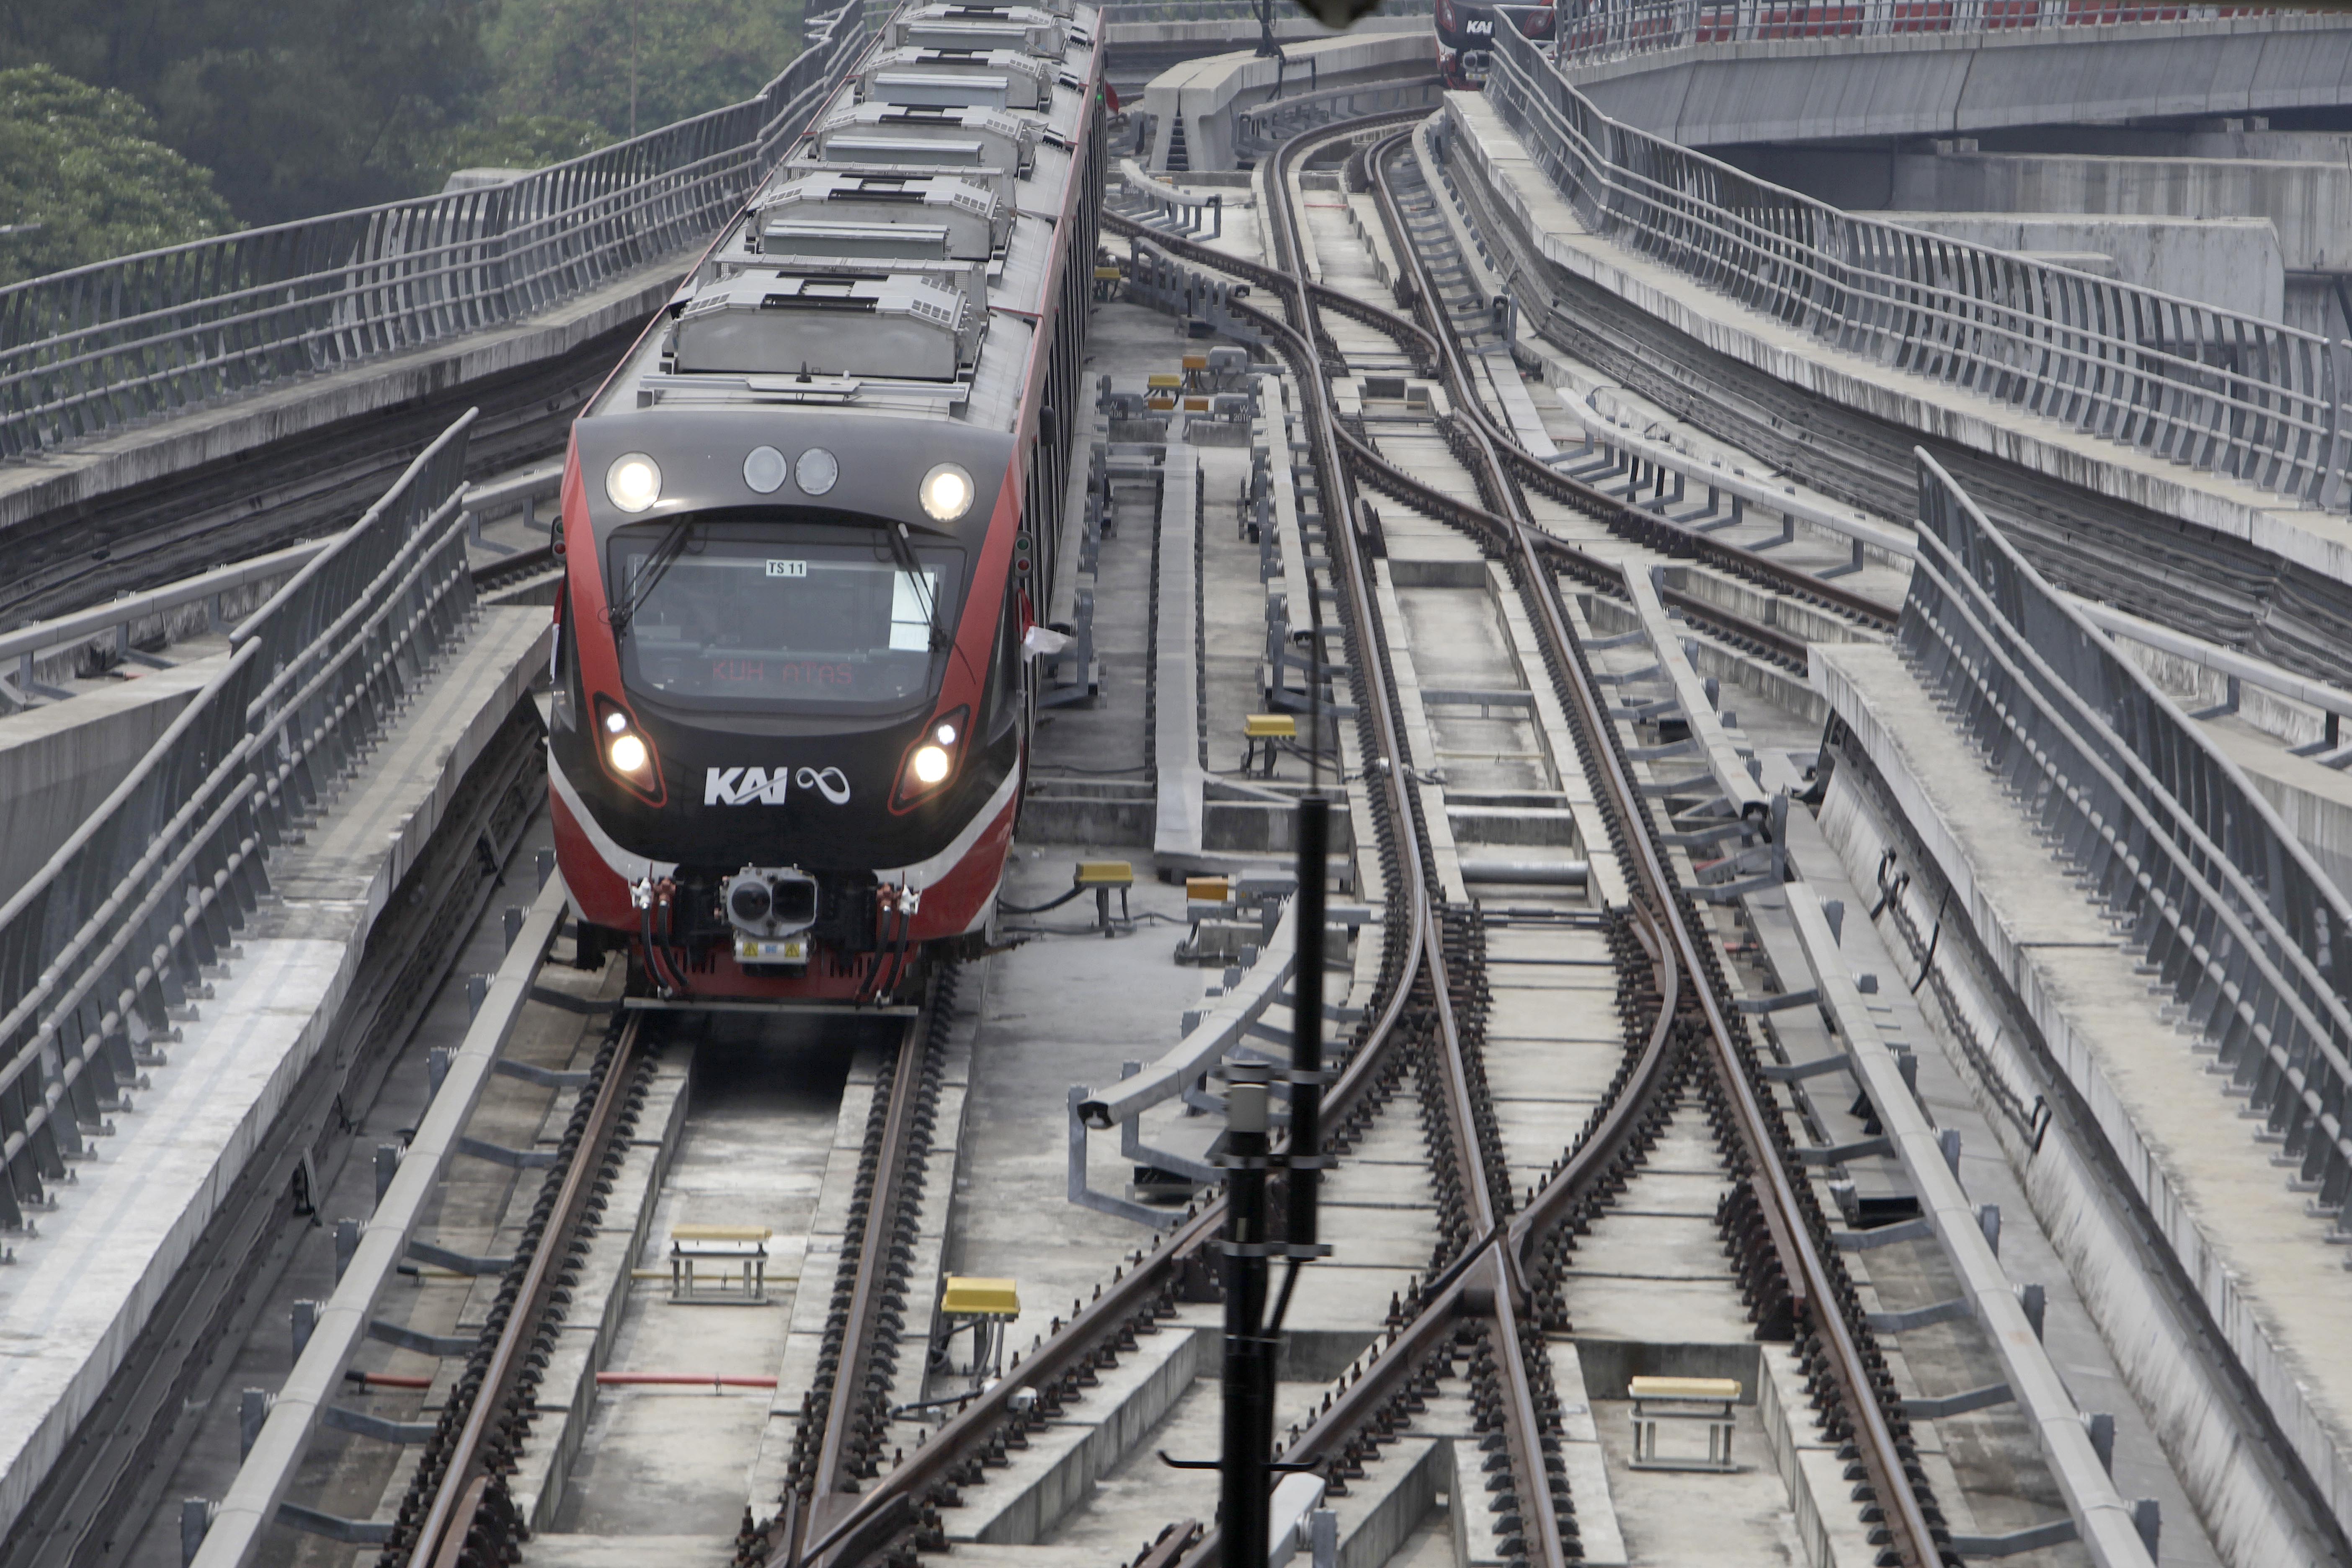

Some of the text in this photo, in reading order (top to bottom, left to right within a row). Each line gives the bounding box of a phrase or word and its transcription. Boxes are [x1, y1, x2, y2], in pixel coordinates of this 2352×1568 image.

[1466, 20, 1493, 35] KAI
[769, 562, 802, 574] TS 11
[784, 662, 853, 684] ATAS
[704, 766, 788, 806] KAI
